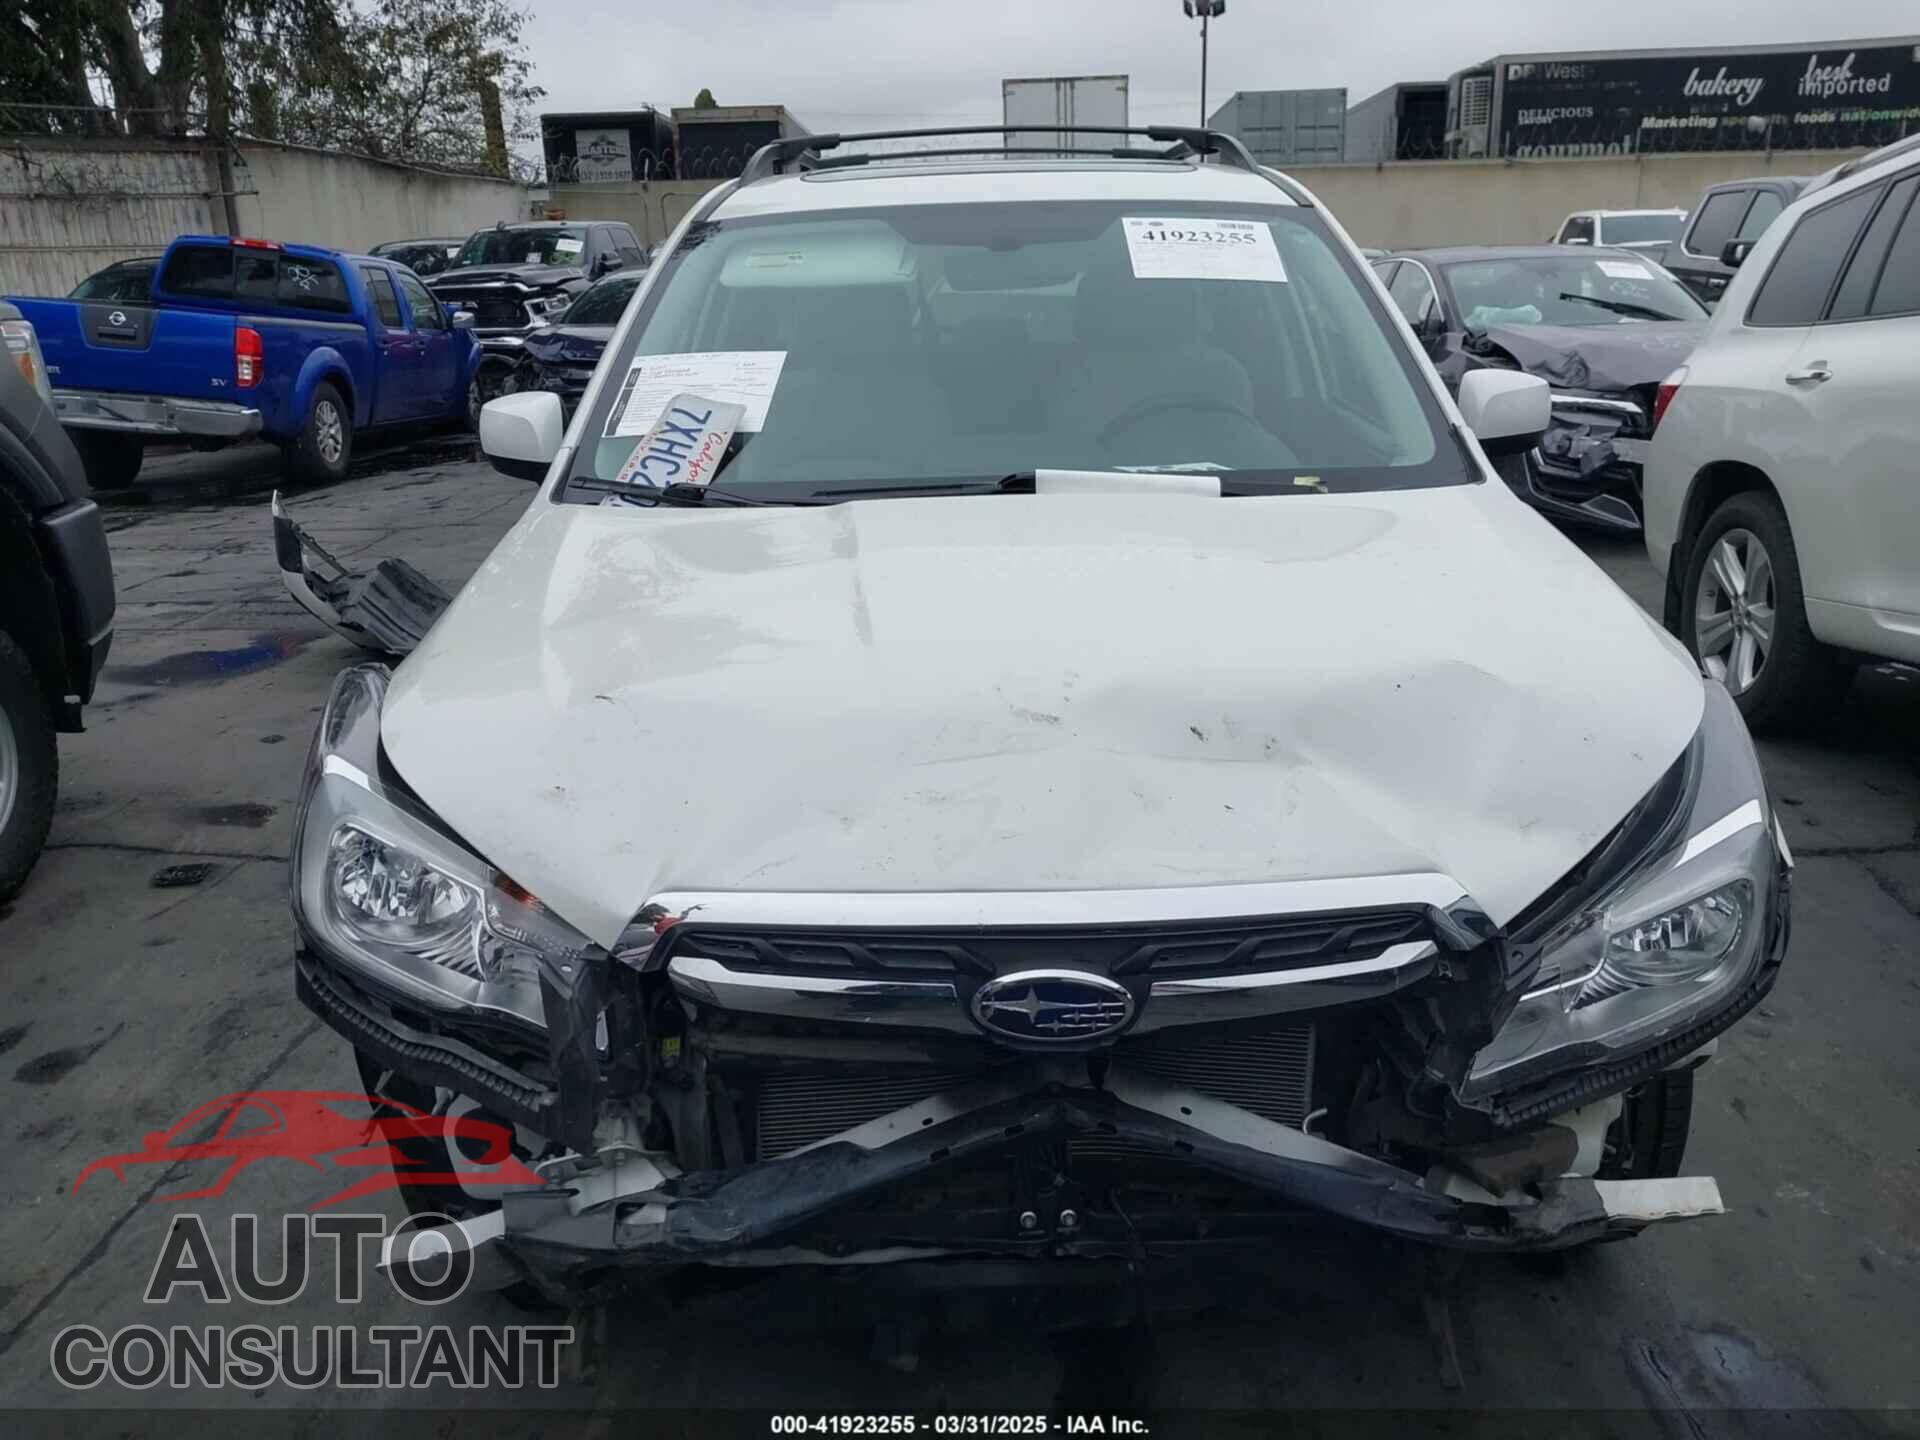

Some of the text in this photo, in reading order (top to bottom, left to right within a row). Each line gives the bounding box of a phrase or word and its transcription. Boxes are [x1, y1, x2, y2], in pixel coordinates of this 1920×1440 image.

[1683, 66, 1764, 106] bakery
[1798, 73, 1891, 99] imported
[1518, 106, 1594, 121] DELICIOUS
[1641, 114, 1719, 129] Marketing
[1794, 111, 1837, 124] foods
[1840, 106, 1920, 121] nationwid
[1142, 229, 1257, 245] 41923255
